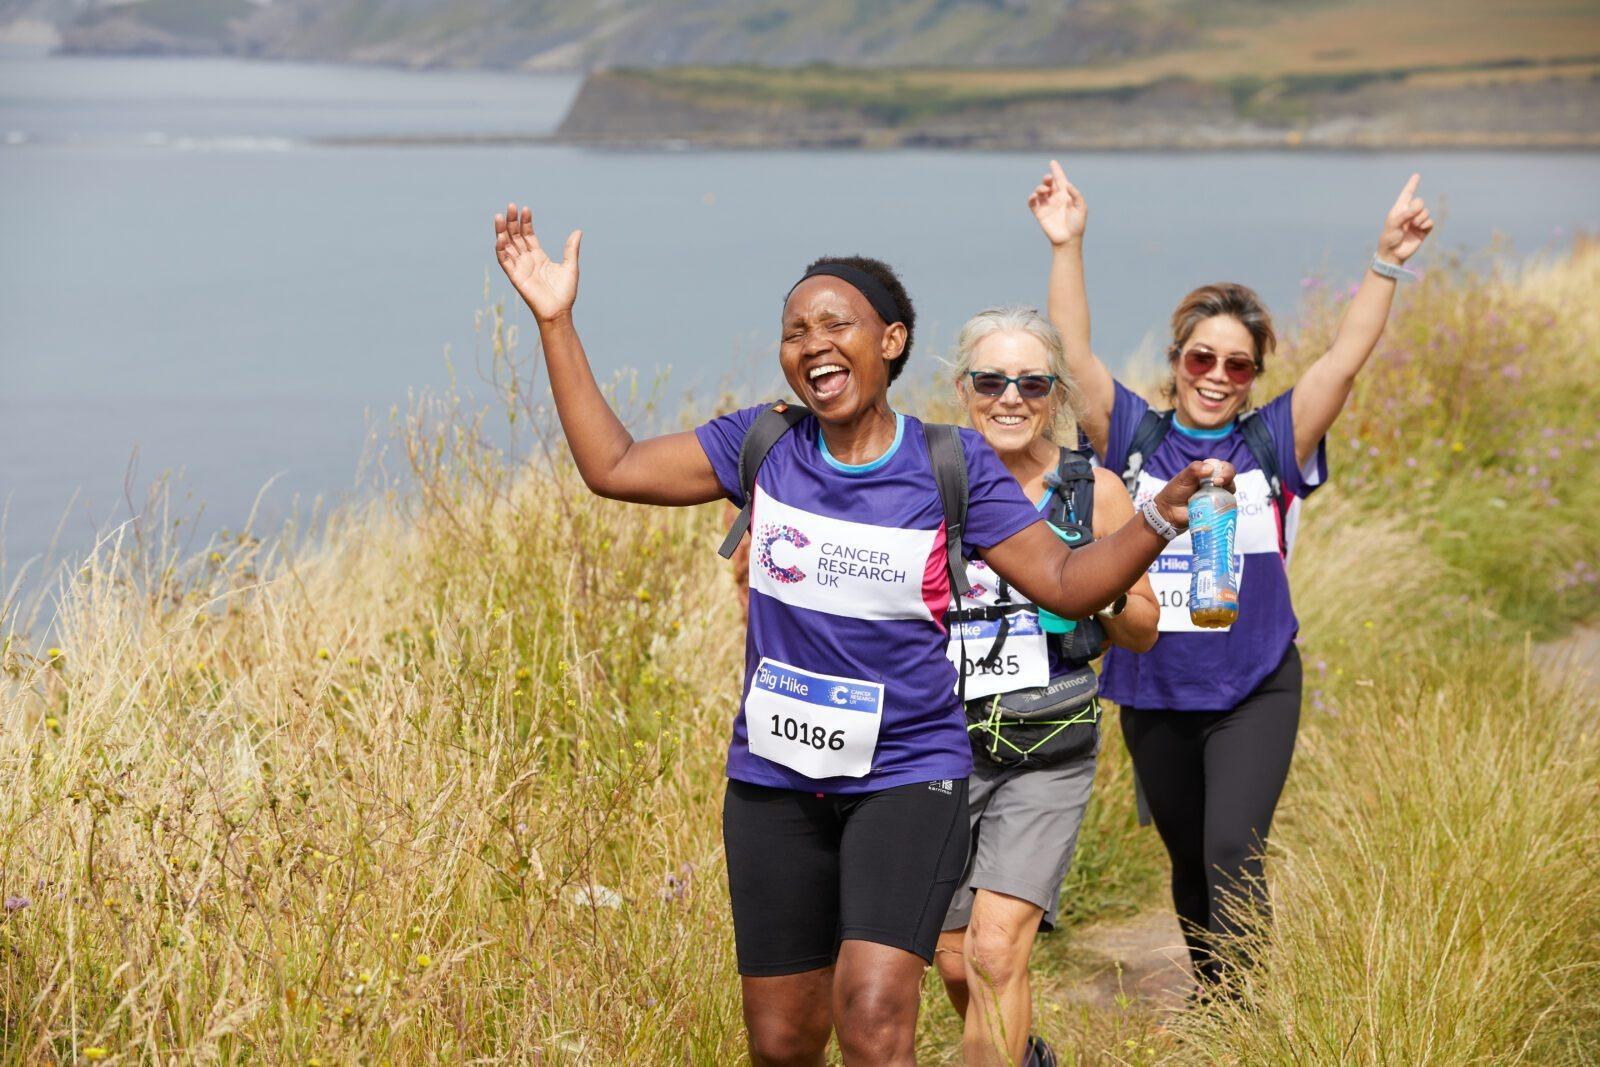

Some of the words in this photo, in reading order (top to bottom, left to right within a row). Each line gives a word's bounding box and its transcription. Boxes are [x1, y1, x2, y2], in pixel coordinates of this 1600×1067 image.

[821, 542, 890, 566] CANCER
[1161, 557, 1190, 571] Hike
[816, 571, 840, 588] UK
[818, 557, 906, 583] RESEARCH
[950, 623, 981, 636] Hike
[760, 669, 778, 689] Big
[780, 674, 809, 696] Hike
[1041, 675, 1089, 697] karrimor
[770, 714, 845, 751] 10186
